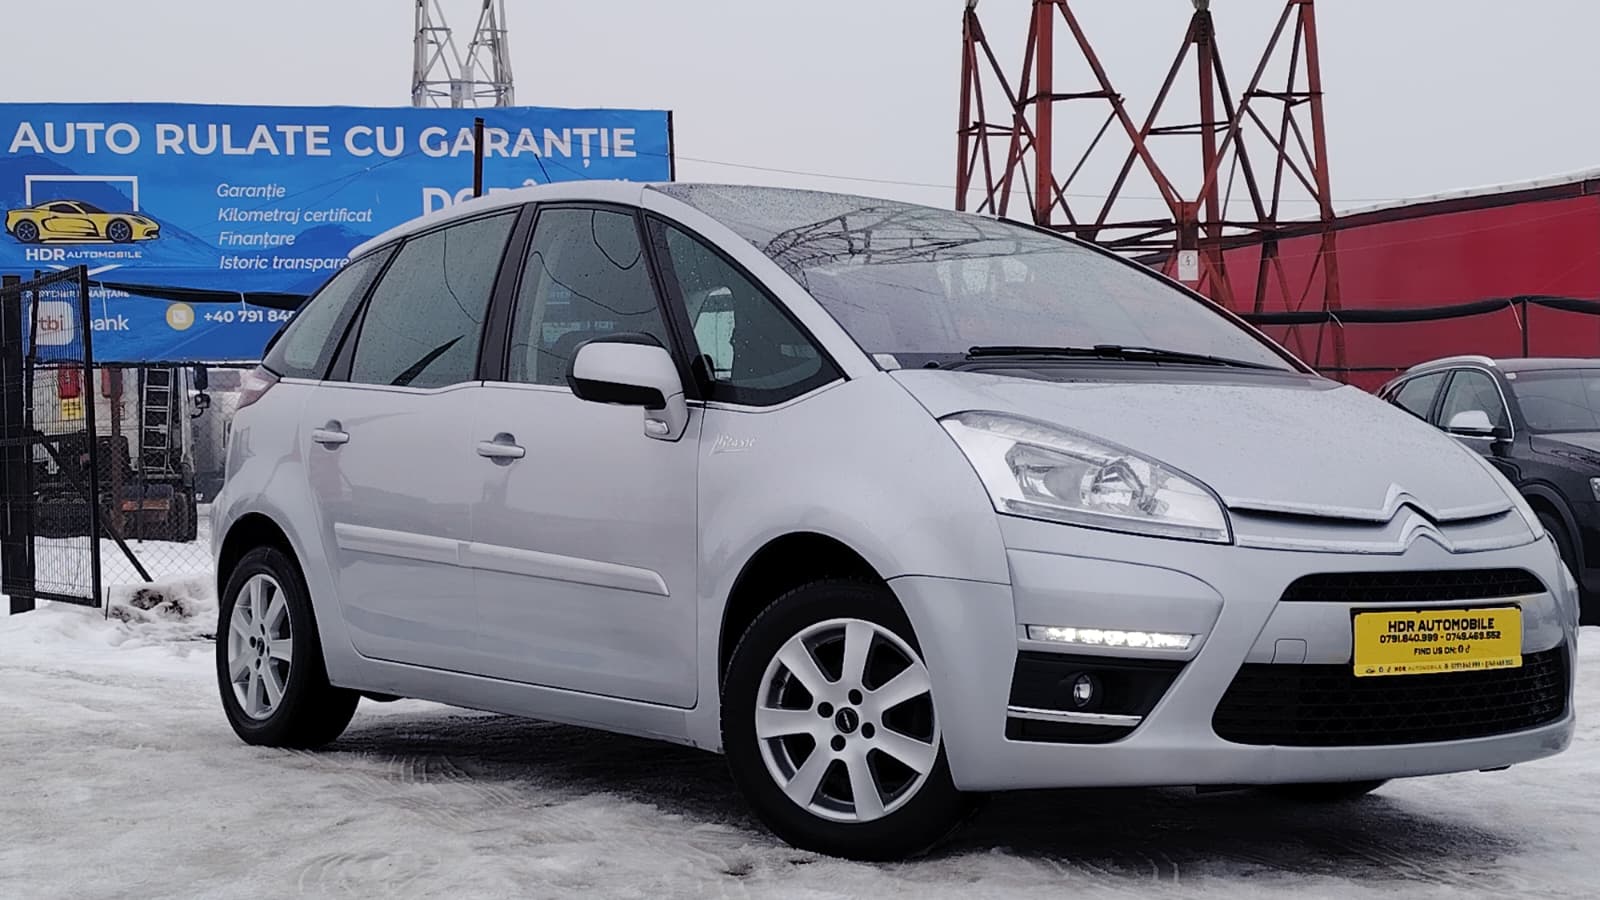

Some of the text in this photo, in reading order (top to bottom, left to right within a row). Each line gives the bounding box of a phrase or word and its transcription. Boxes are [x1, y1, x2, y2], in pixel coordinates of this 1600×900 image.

[8, 122, 637, 168] AUTO RULATE CU GARANȚIE
[216, 184, 286, 201] Garanție
[218, 208, 372, 225] Kilometraj certificat
[219, 232, 296, 247] Finanțare
[25, 249, 142, 262] HDR AUTOMOBILE
[219, 255, 350, 272] Istoric transpare
[40, 315, 64, 331] tbi
[203, 310, 235, 322] +40
[237, 310, 264, 323] 791
[1388, 618, 1495, 633] HDR AUTOMOBILE
[1414, 647, 1431, 656] FIND
[1432, 647, 1443, 655] US
